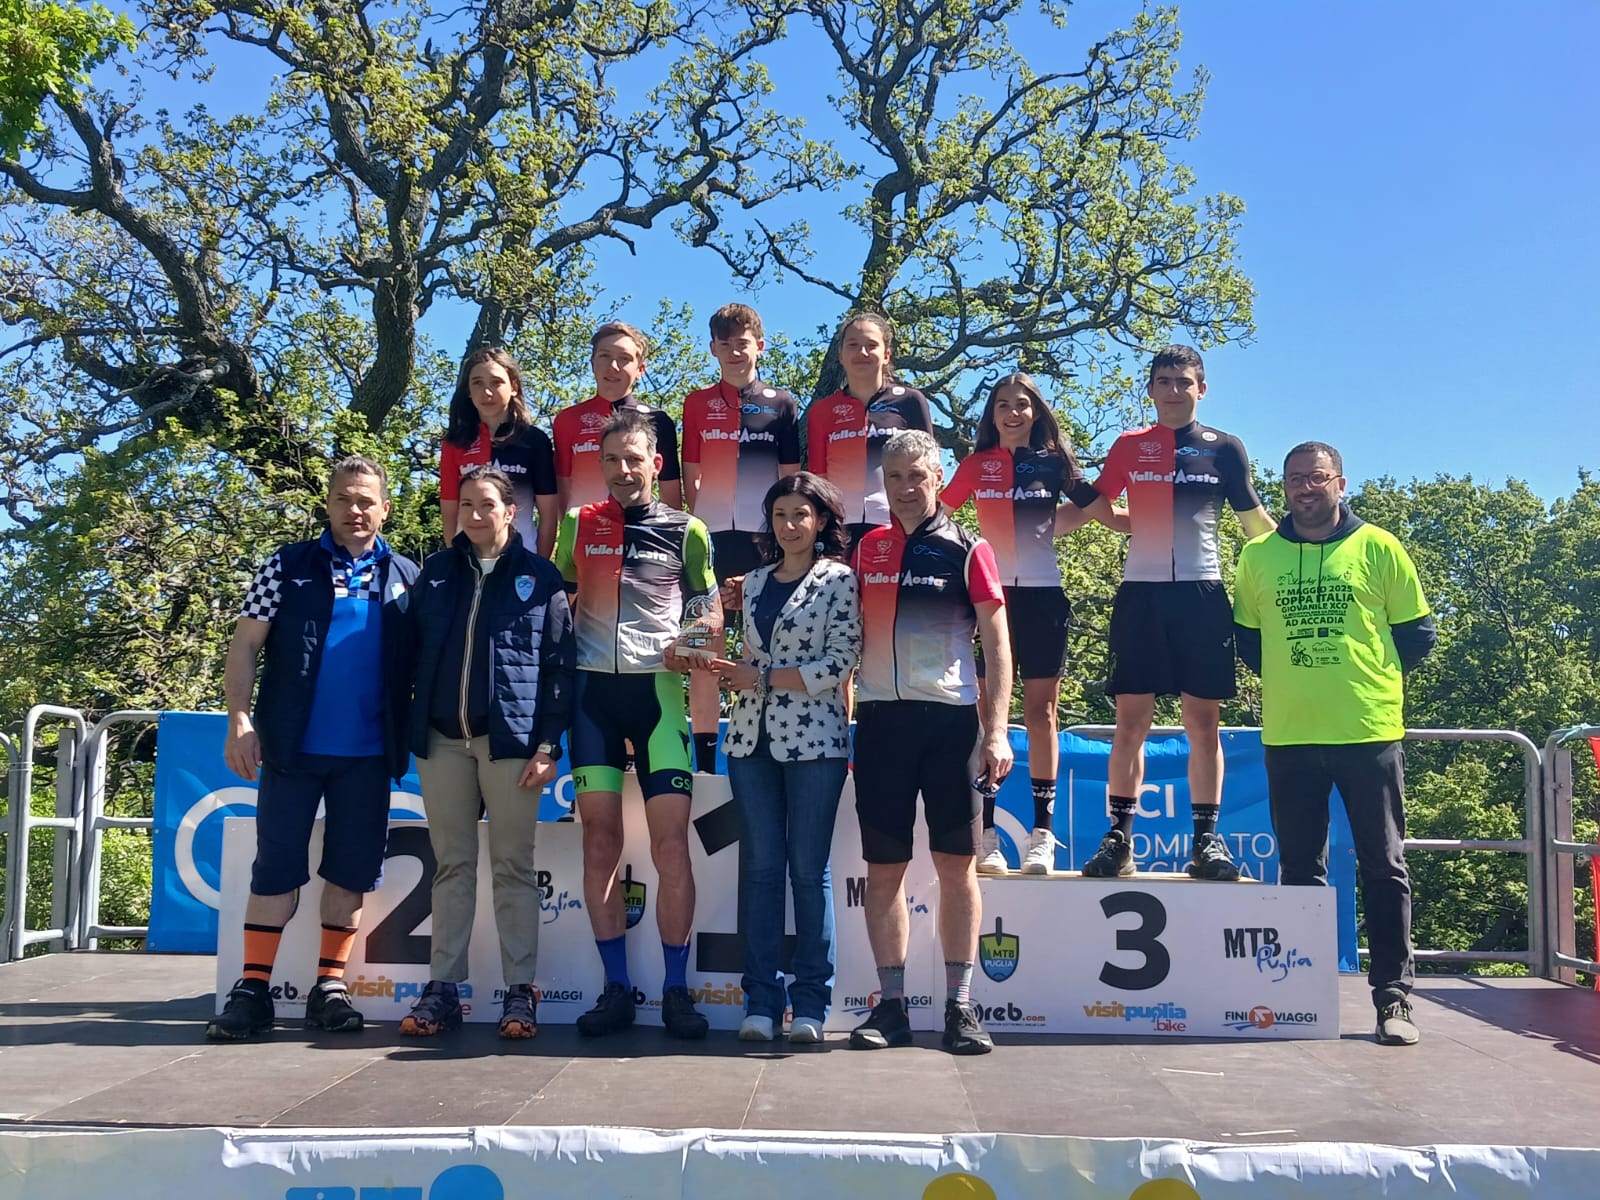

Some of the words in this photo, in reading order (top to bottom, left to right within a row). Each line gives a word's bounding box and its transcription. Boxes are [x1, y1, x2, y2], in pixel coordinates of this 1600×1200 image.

[699, 429, 728, 443] Valle
[858, 423, 898, 438] d'Aost
[572, 441, 600, 456] Valle
[1128, 470, 1162, 484] Valle
[1163, 468, 1219, 484] d'Aosta
[974, 488, 1003, 501] Valle
[584, 544, 614, 558] Valle
[863, 572, 889, 587] Valle
[1287, 585, 1327, 596] MAGGIO
[1329, 584, 1353, 593] 2025
[1275, 594, 1314, 607] COPPA
[1316, 593, 1355, 603] ITALIA
[1281, 602, 1328, 613] GIOVANILE
[1330, 602, 1348, 610] XCO
[1285, 619, 1299, 628] AD
[1300, 616, 1344, 625] ACCADIA
[365, 826, 438, 964] 2
[1099, 891, 1170, 991] 3
[1223, 927, 1281, 959] MTB
[992, 949, 1015, 958] MTB
[984, 959, 1013, 968] PUGLIA
[1256, 945, 1312, 983] Puglia
[541, 990, 583, 1001] VIAGGI
[844, 996, 867, 1007] FINI
[1083, 1001, 1187, 1023] visitpuglia
[1225, 1010, 1248, 1021] FINI
[1274, 1012, 1318, 1023] VIAGGI
[1153, 1019, 1186, 1032] .bike
